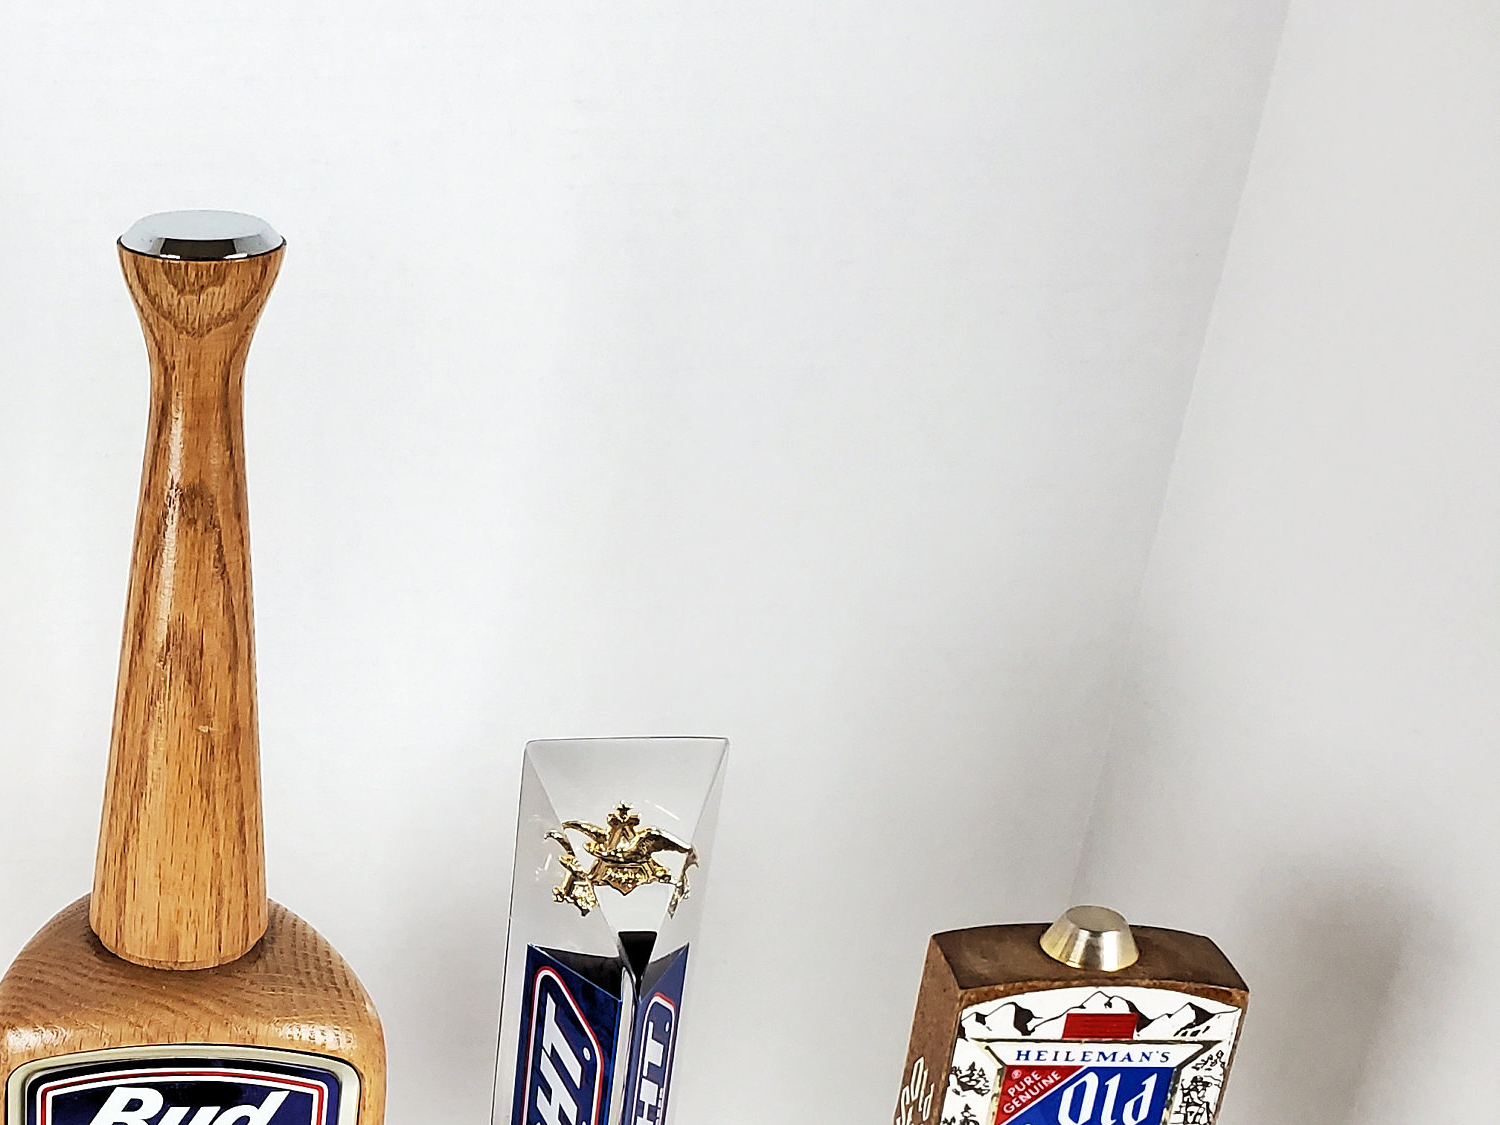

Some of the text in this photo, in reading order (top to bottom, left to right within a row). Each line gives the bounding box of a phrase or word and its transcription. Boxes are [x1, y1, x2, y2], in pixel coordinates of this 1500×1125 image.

[1015, 1049, 1172, 1063] HEILEMAN'S
[910, 1056, 935, 1121] Old
[1002, 1070, 1062, 1114] GENUINE
[1007, 1070, 1042, 1098] PURE
